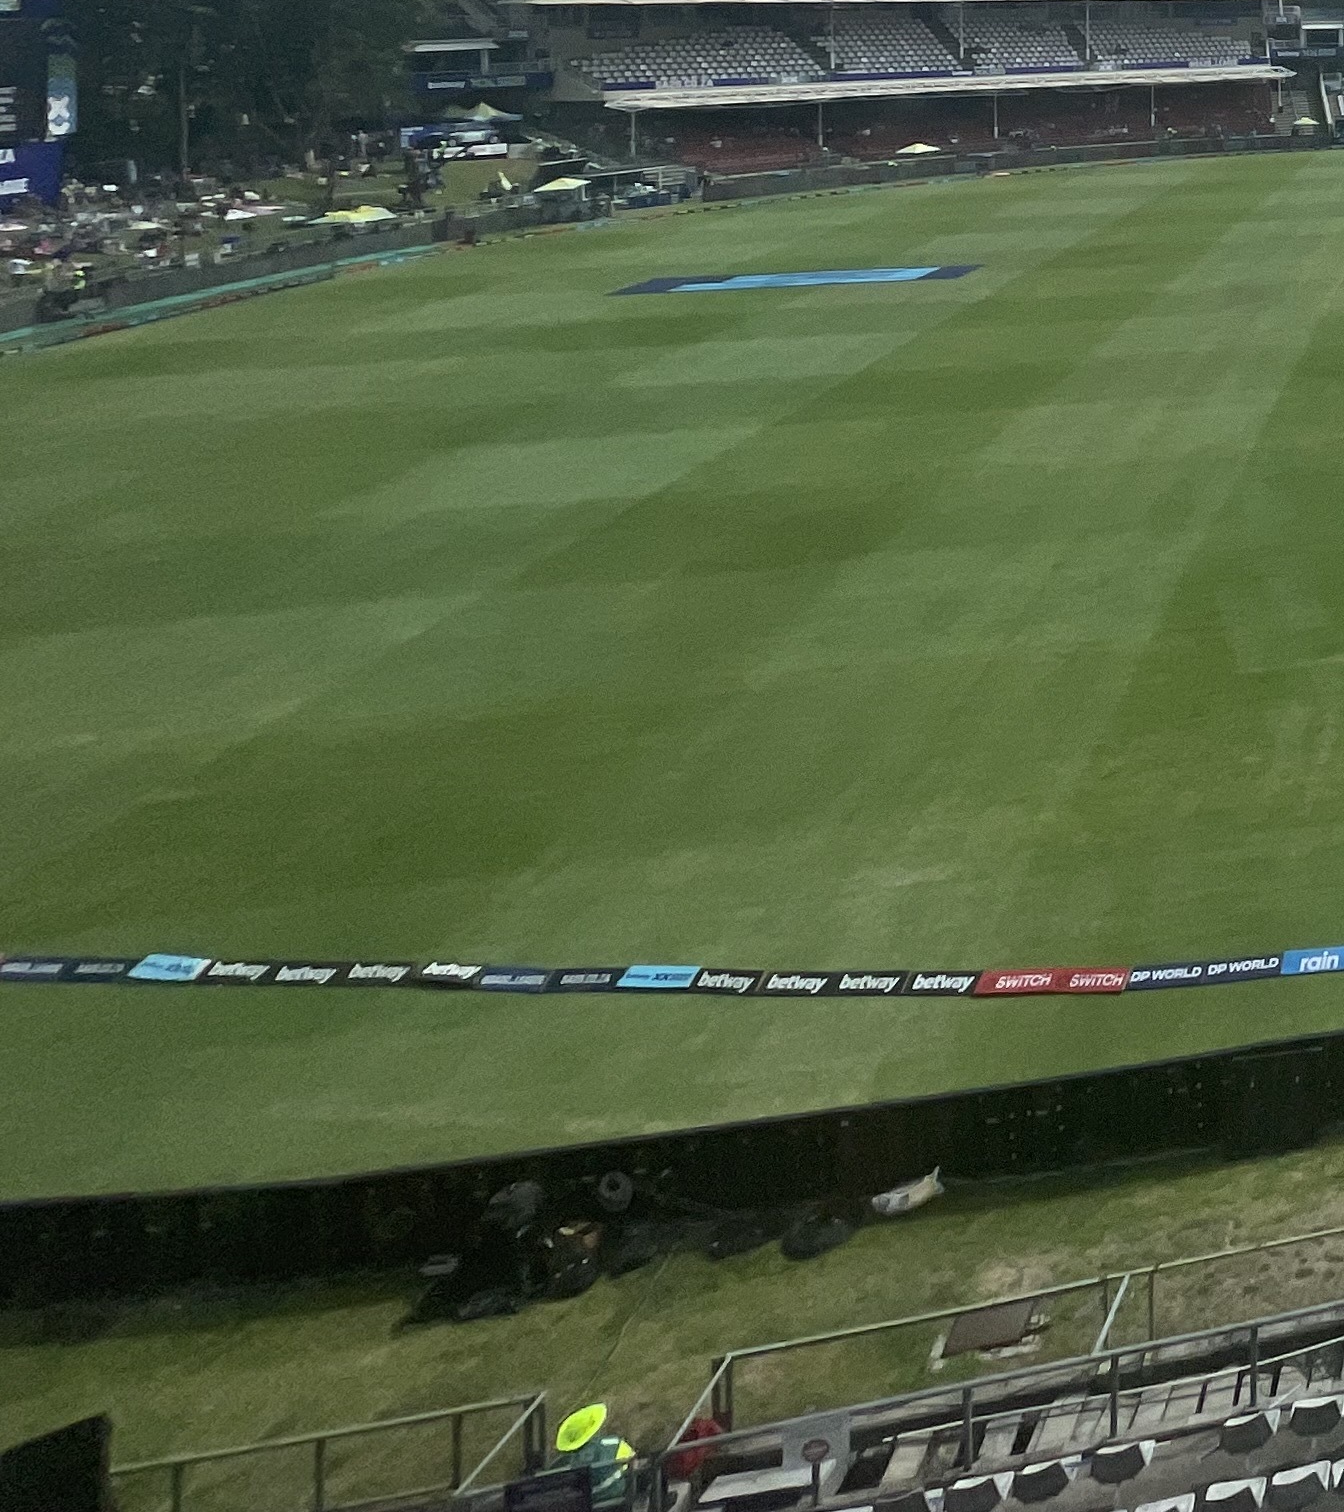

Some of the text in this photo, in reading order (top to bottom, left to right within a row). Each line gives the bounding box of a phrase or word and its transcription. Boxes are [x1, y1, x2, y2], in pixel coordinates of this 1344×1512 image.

[1130, 956, 1280, 984] DP WORLD DP WORLD
[1298, 950, 1340, 972] rain
[207, 960, 270, 981] betway
[274, 965, 338, 984] betway
[347, 963, 411, 982] betway
[422, 960, 482, 980] betway
[698, 972, 754, 994] betway
[766, 973, 828, 994] betway
[838, 973, 899, 994] betway
[912, 973, 975, 994] betway
[994, 972, 1124, 990] SWITCH SWITCH
